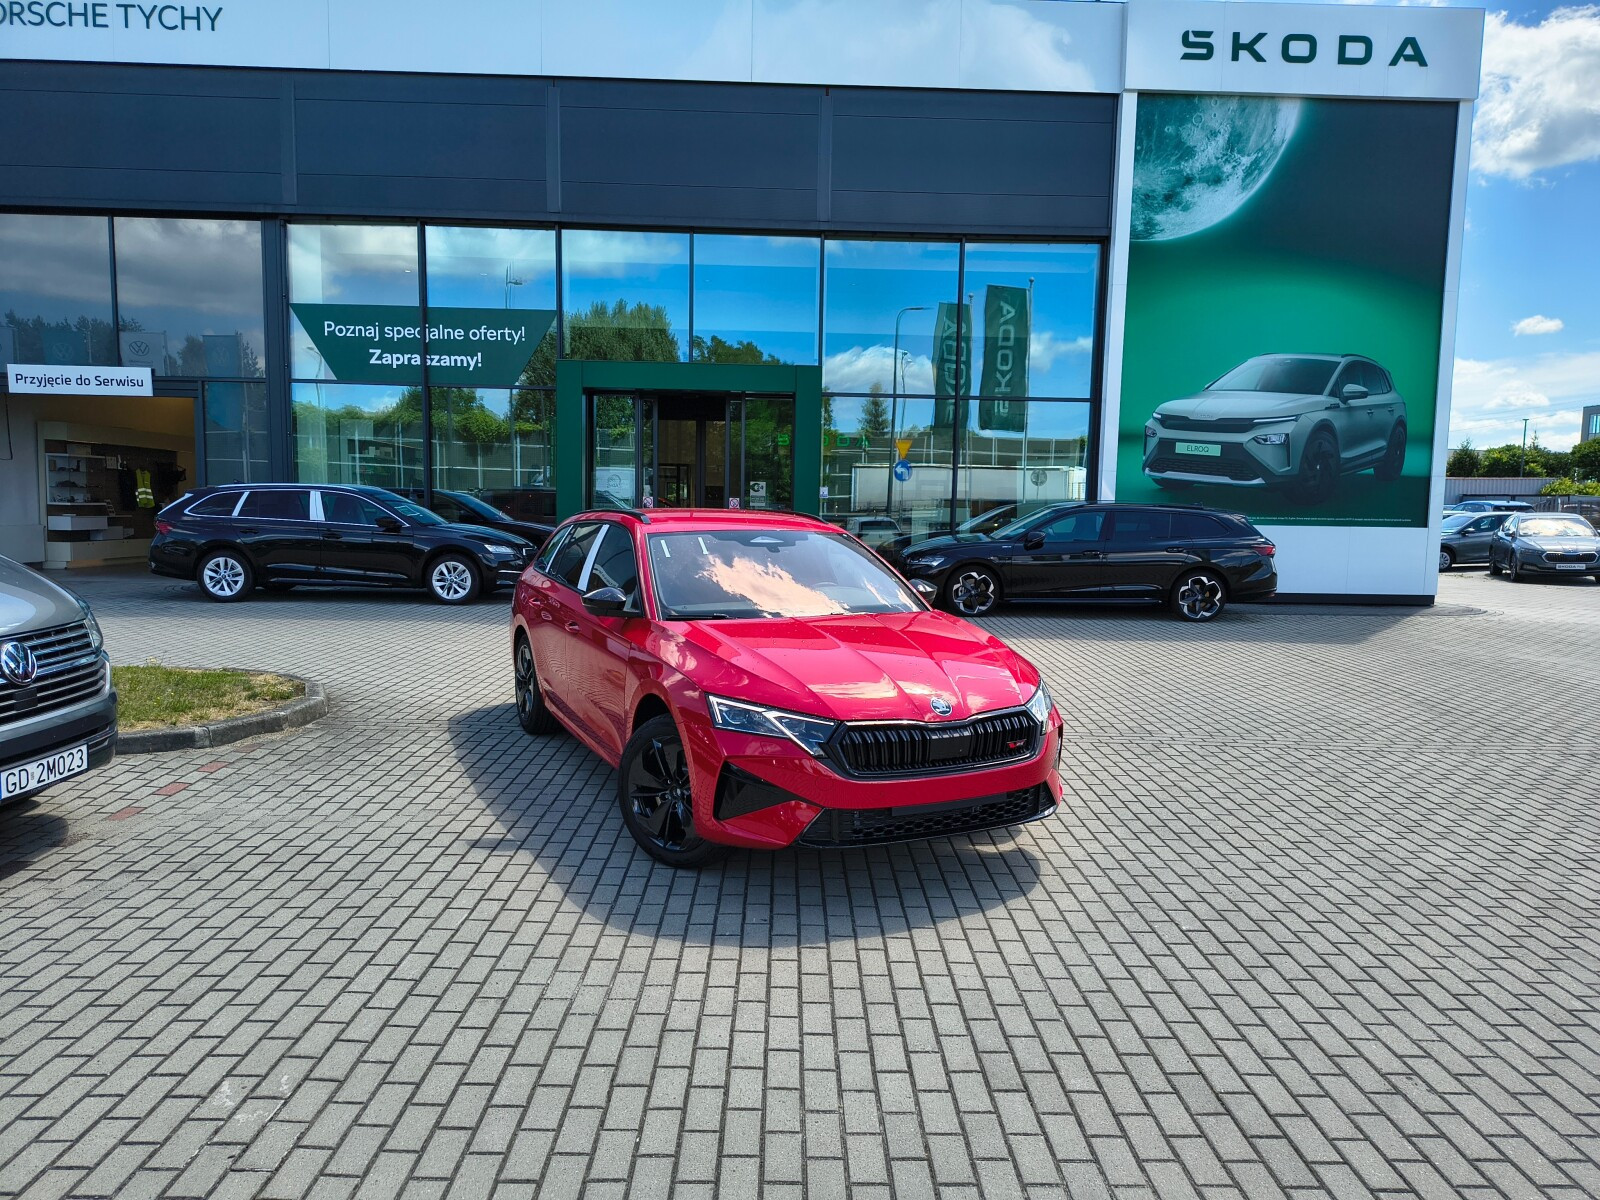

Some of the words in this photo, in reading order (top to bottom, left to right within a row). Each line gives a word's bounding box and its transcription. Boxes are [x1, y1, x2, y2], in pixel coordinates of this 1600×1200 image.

[116, 4, 223, 31] TYCHY
[324, 321, 379, 341] Poznaj
[384, 324, 464, 342] specjalne
[469, 326, 525, 345] oferty!
[369, 349, 482, 370] Zapraszamy!
[15, 373, 72, 387] Przyjęcie
[76, 375, 91, 386] do
[95, 376, 144, 387] Serwisu
[1186, 445, 1209, 453] ELROQ
[6, 768, 29, 794] GD
[36, 748, 84, 784] 2M023
